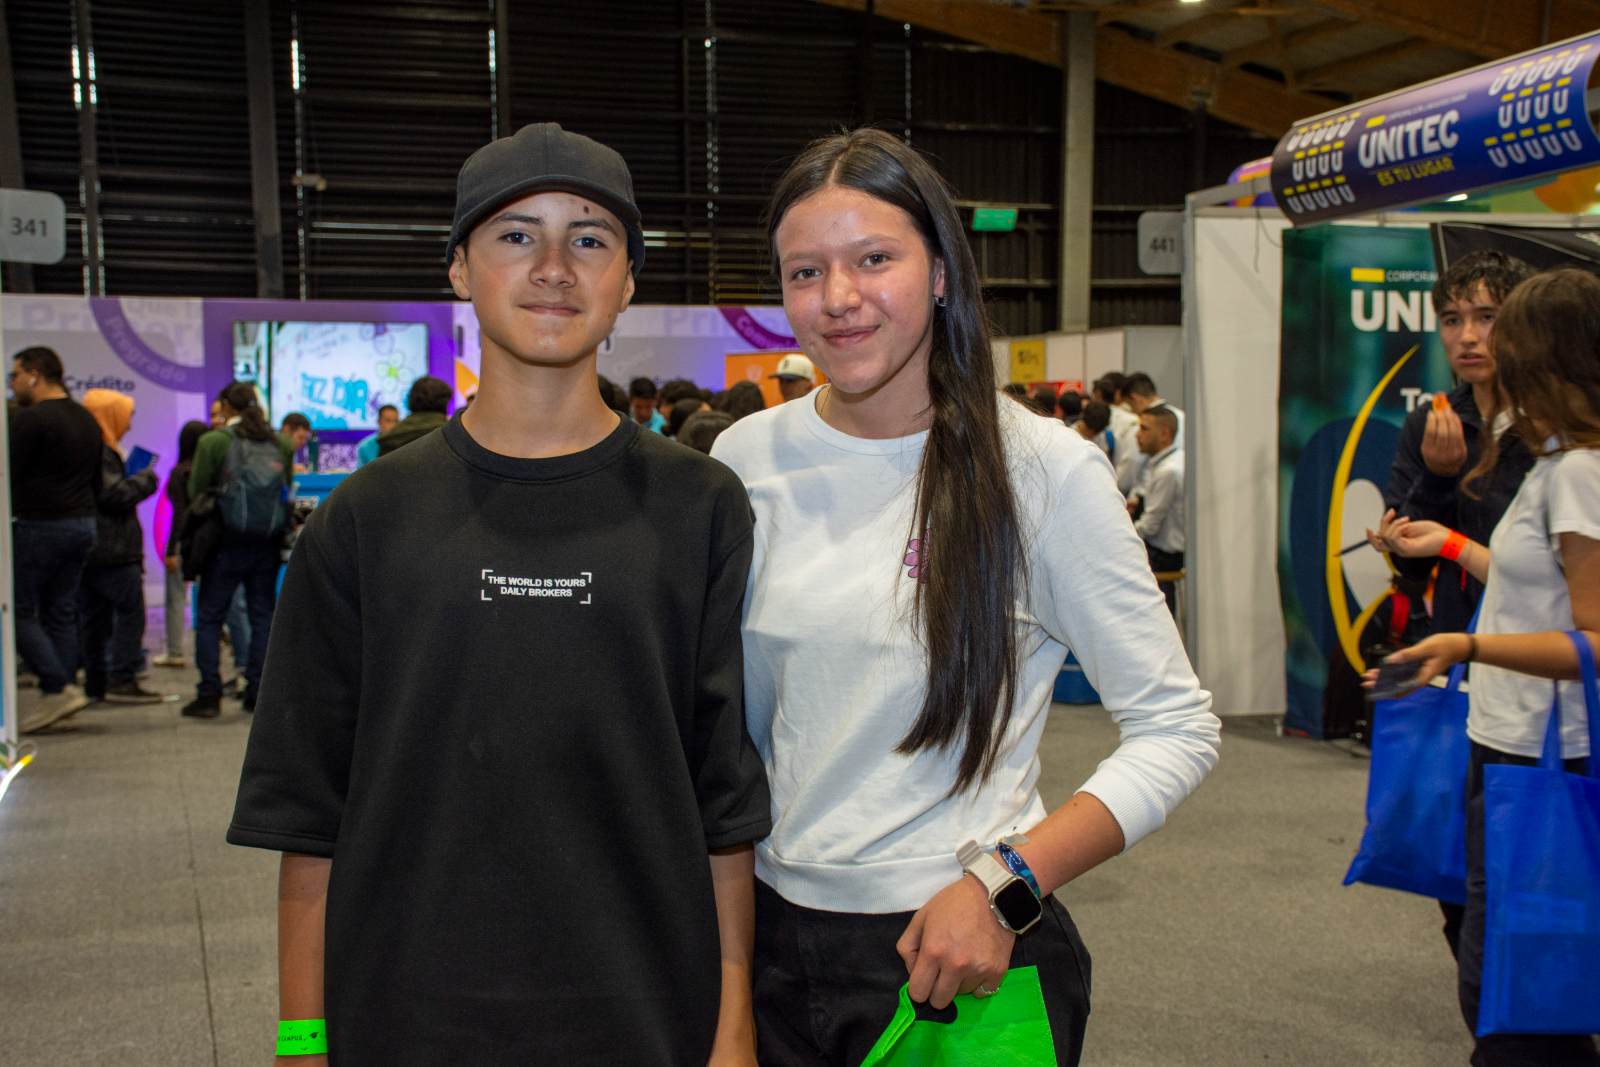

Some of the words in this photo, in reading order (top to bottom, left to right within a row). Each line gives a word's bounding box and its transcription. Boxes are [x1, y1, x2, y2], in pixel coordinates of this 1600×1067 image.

[1358, 109, 1459, 168] UNITEC
[1376, 171, 1398, 187] ES
[1394, 166, 1413, 184] TU
[1410, 155, 1455, 180] LUGAR
[10, 216, 48, 237] 341
[1149, 238, 1175, 253] 441
[488, 576, 506, 585] THE
[508, 577, 542, 587] WORLD
[544, 579, 553, 587] IS
[555, 579, 586, 587] YOURS
[500, 587, 527, 596] DAILY
[529, 589, 573, 597] BROKERS
